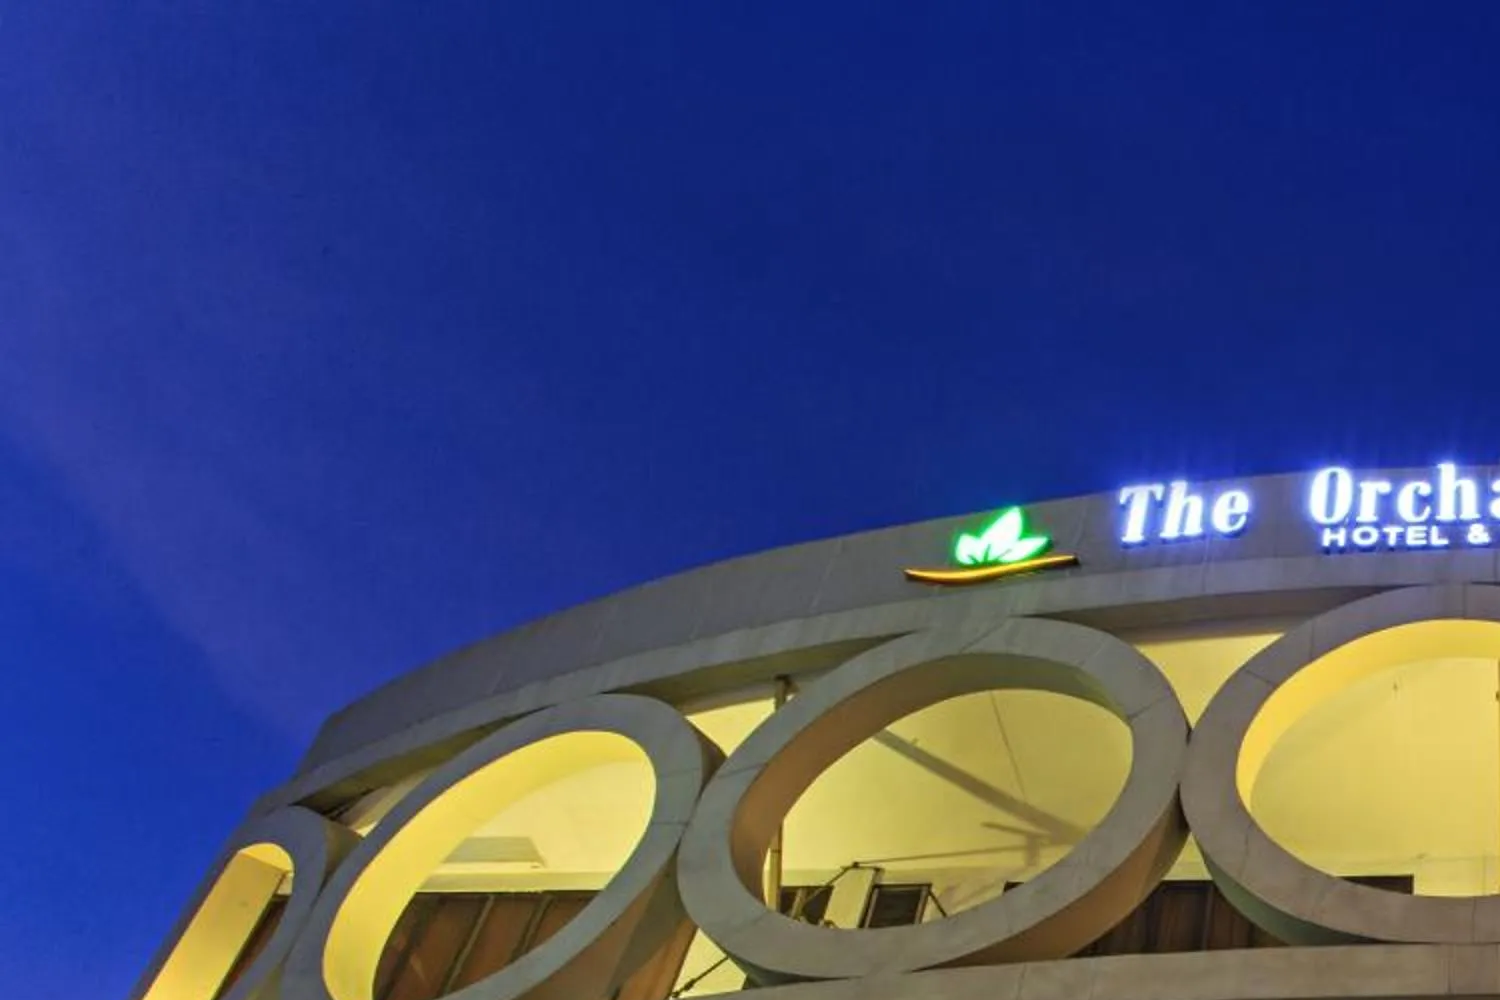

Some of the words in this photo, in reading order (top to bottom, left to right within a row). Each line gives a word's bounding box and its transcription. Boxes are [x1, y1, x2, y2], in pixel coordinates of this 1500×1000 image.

[1118, 480, 1251, 545] The
[1322, 525, 1449, 548] HOTEL
[1467, 523, 1491, 545] &
